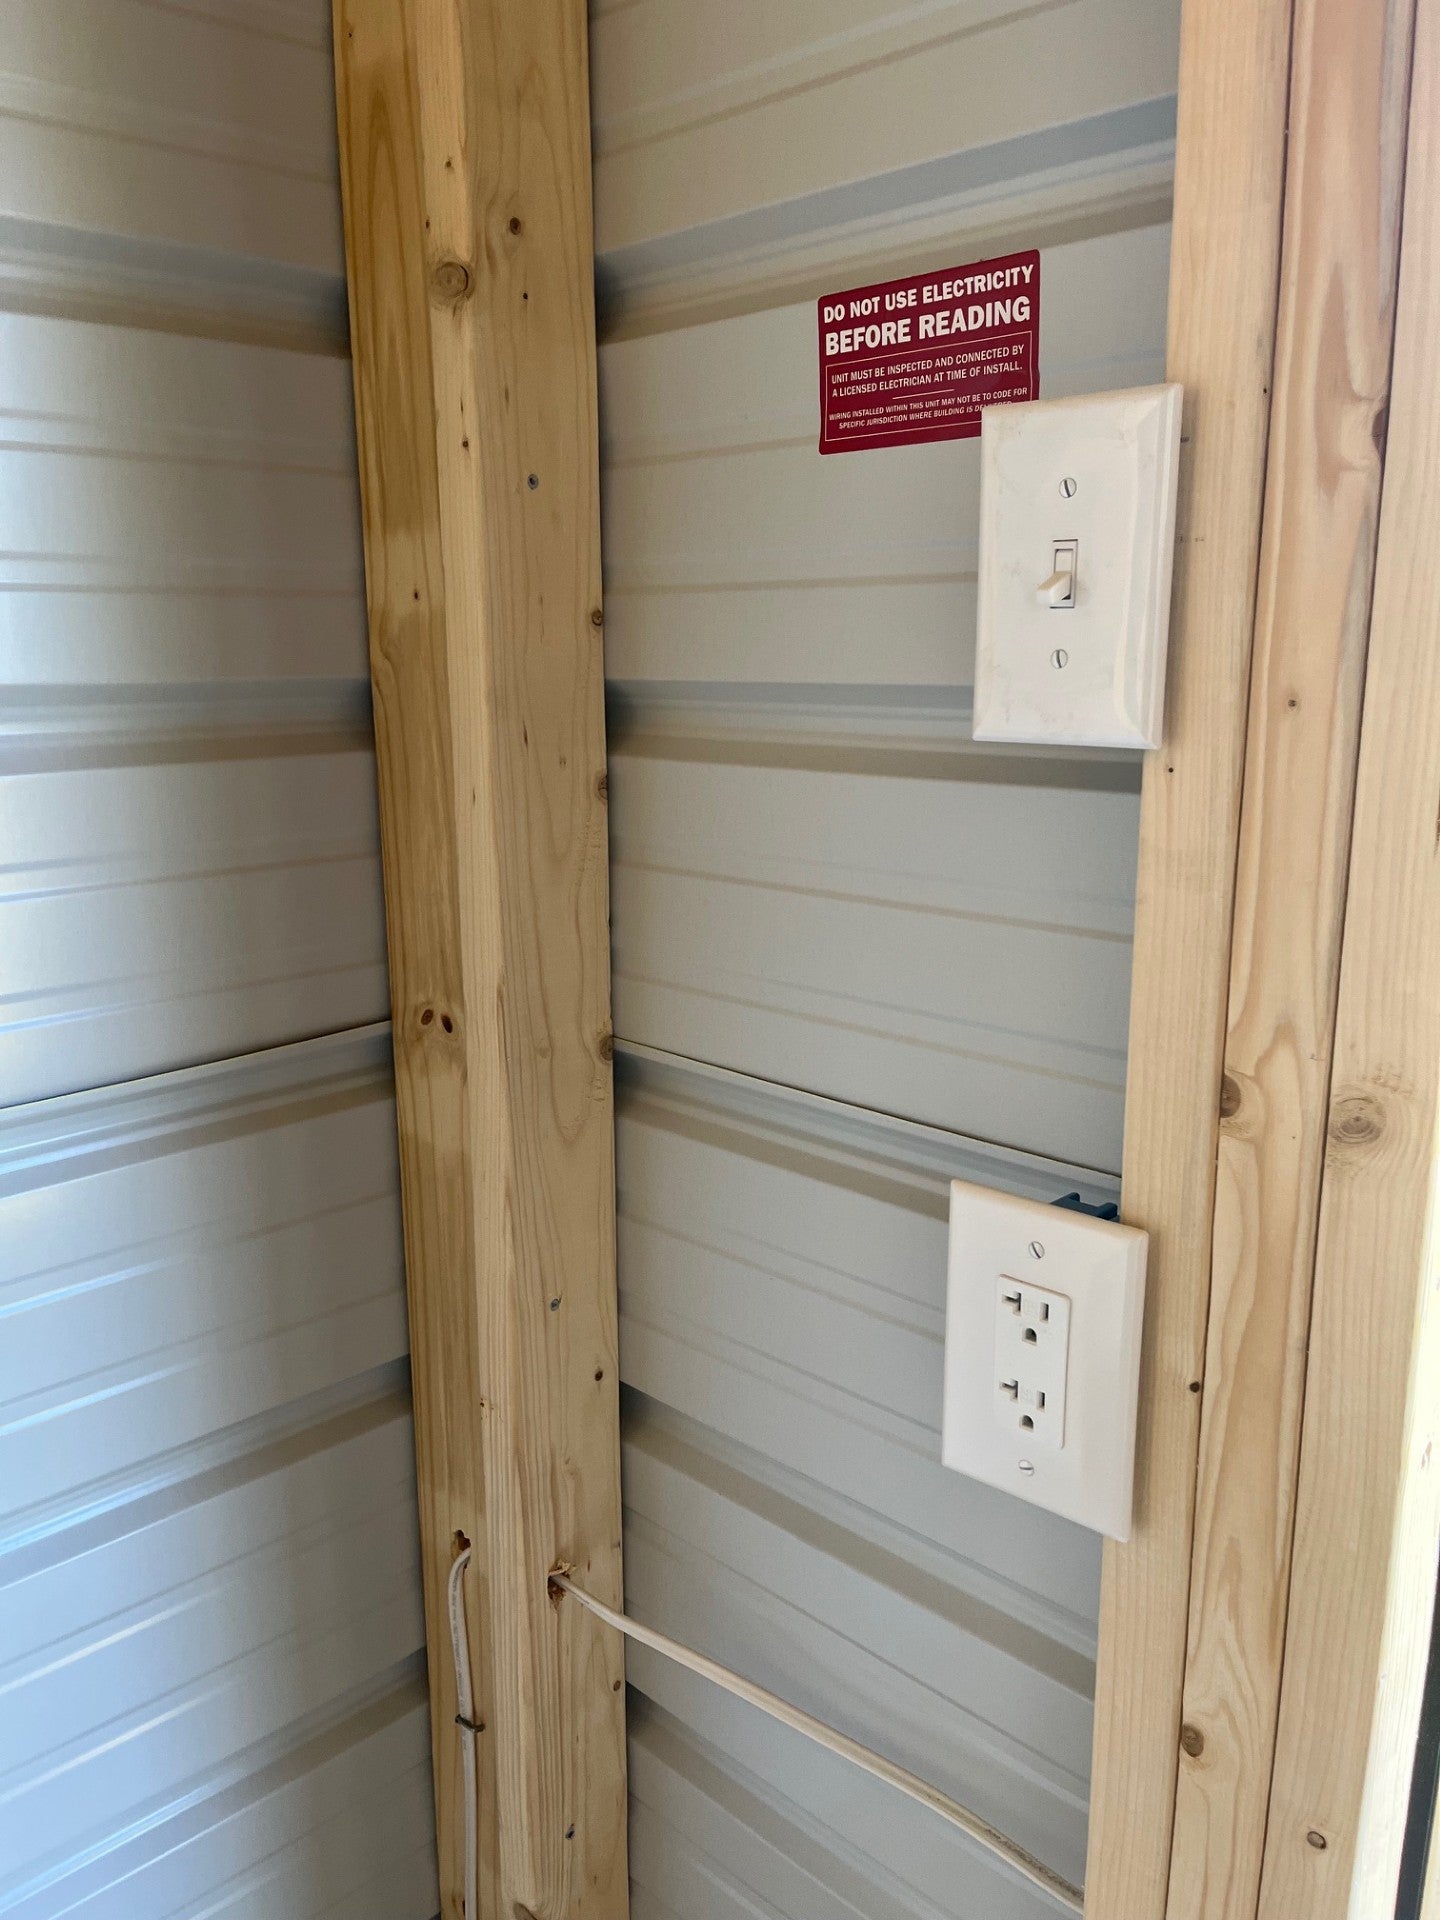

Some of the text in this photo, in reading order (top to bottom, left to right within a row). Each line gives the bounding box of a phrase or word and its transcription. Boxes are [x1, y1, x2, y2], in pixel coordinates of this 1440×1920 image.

[824, 264, 1034, 324] DO NOT USE ELECTRICITY
[825, 296, 1031, 356] BEFORE READING
[831, 344, 1025, 384] UNIT MUST BE INSPECTED AND CONNECTED BY
[832, 361, 1023, 398] A LICENSED ELECTRICIAN AT TIME OF INSTALL.
[829, 387, 1028, 421] WIRING INSTALLED WITHIN THIS UNIT MAY NOT BE TO CODE FOR
[839, 420, 866, 430] SPECIFIC
[866, 415, 908, 426] JURISDICTION
[909, 410, 933, 420] WHERE
[933, 406, 965, 418] BUILDING
[966, 404, 974, 413] IS
